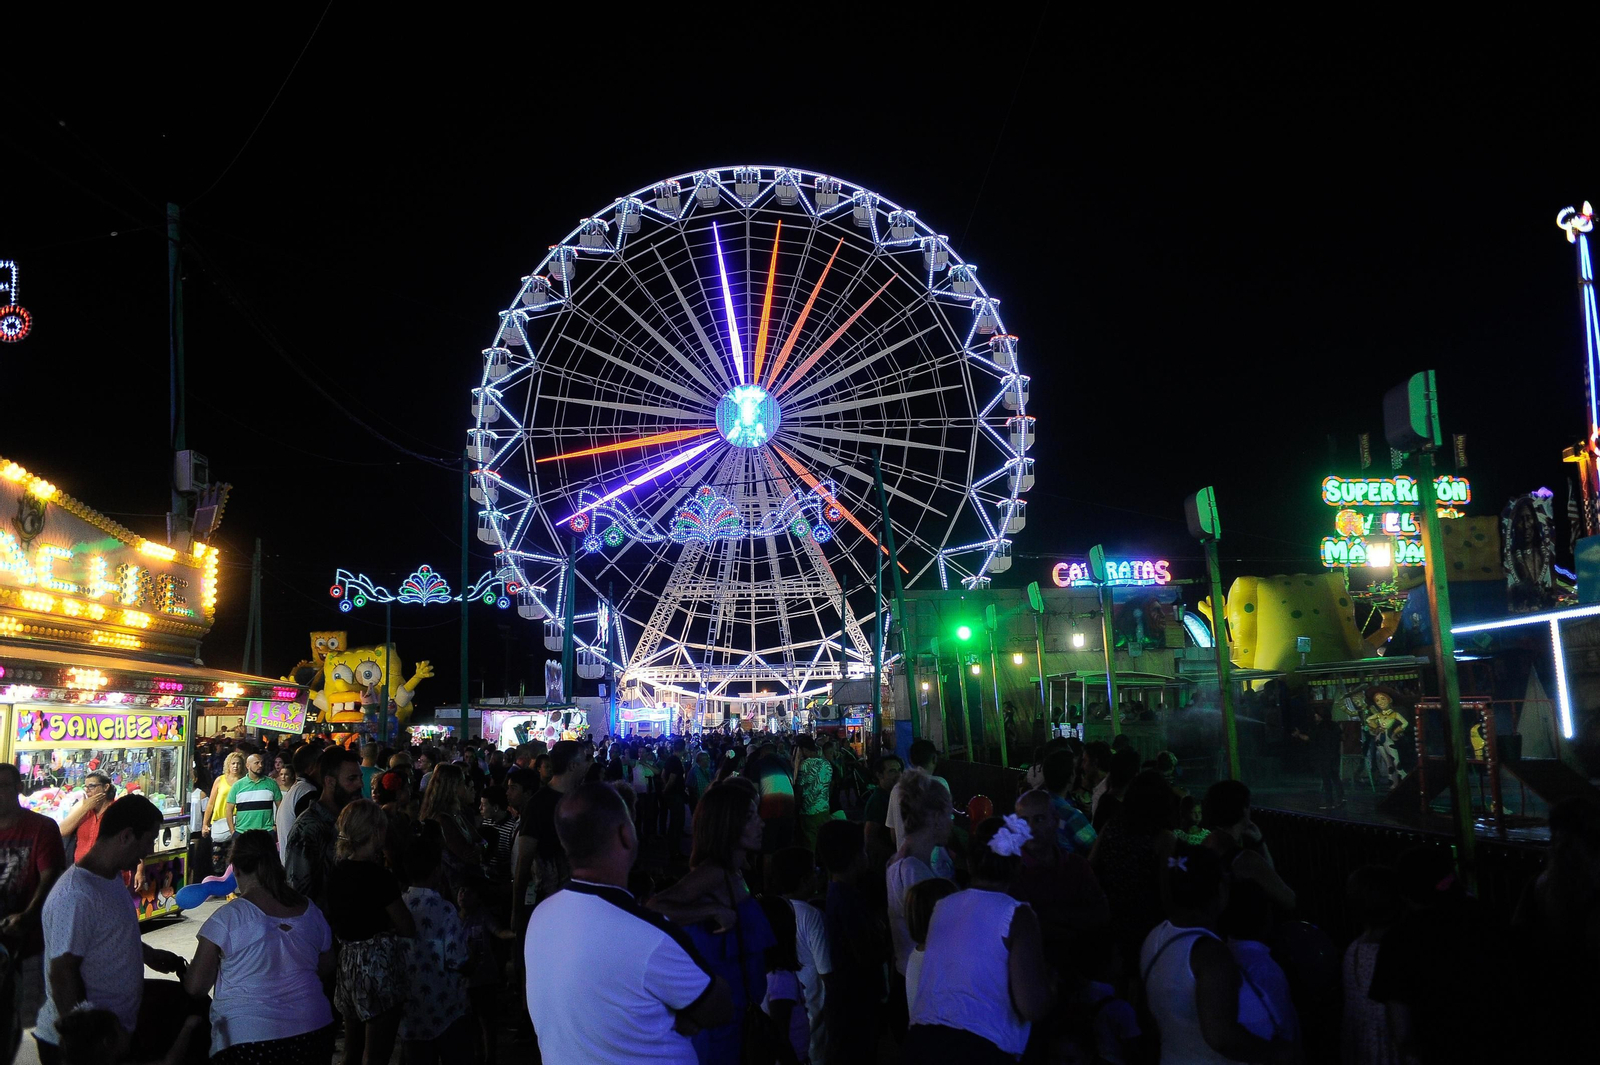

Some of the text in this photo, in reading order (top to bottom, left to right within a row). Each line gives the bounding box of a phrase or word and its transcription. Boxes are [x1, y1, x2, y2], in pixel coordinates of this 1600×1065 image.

[1325, 476, 1467, 502] SUPERRÓN
[1386, 512, 1416, 532] EL
[1052, 560, 1171, 587] CATRATAS
[50, 714, 152, 740] SANCHEZ
[249, 713, 259, 724] 2
[261, 717, 300, 731] PARTIDAS
